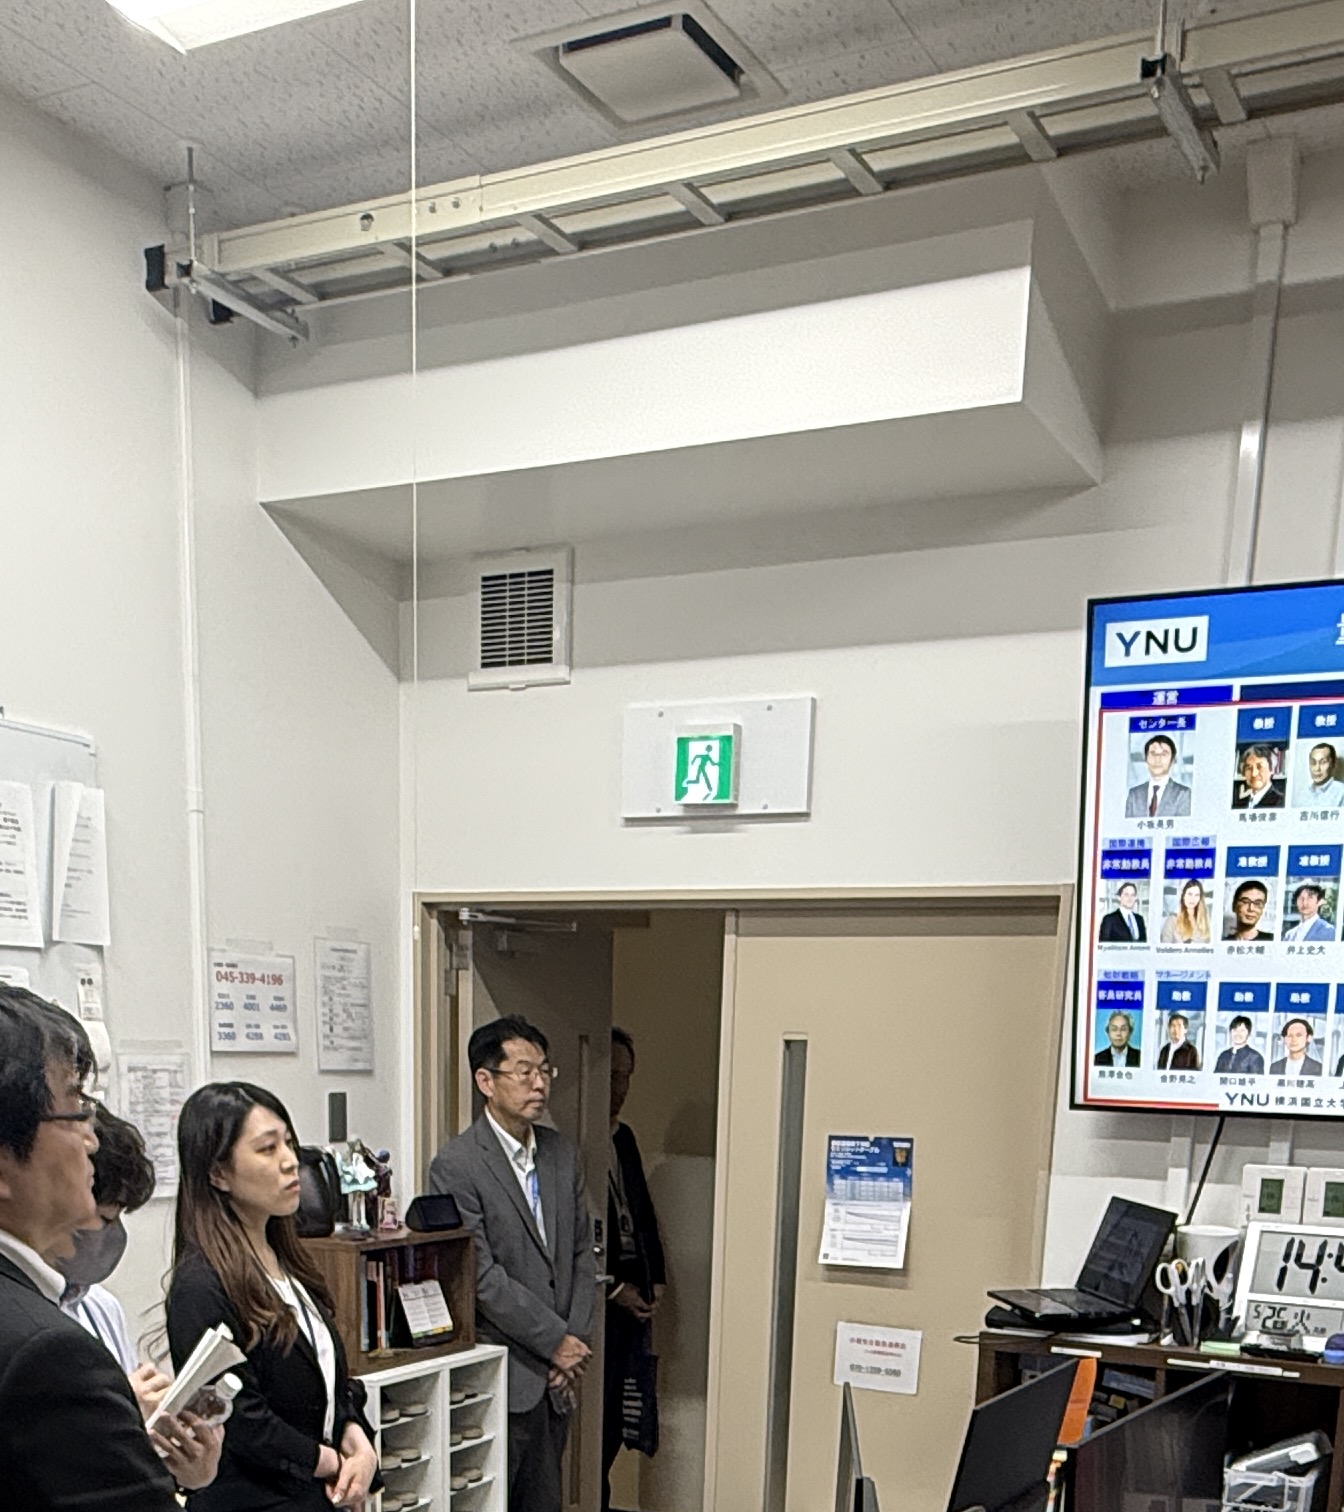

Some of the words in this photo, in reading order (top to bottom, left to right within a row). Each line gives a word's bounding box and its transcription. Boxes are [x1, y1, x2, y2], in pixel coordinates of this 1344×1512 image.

[1115, 626, 1198, 657] YNU
[1152, 691, 1179, 705] 運営
[1138, 716, 1187, 729] センター長
[1315, 714, 1337, 727] 教授
[1298, 854, 1331, 867] 准教授
[216, 970, 284, 986] 045-339-4196
[1225, 1092, 1270, 1106] YNU
